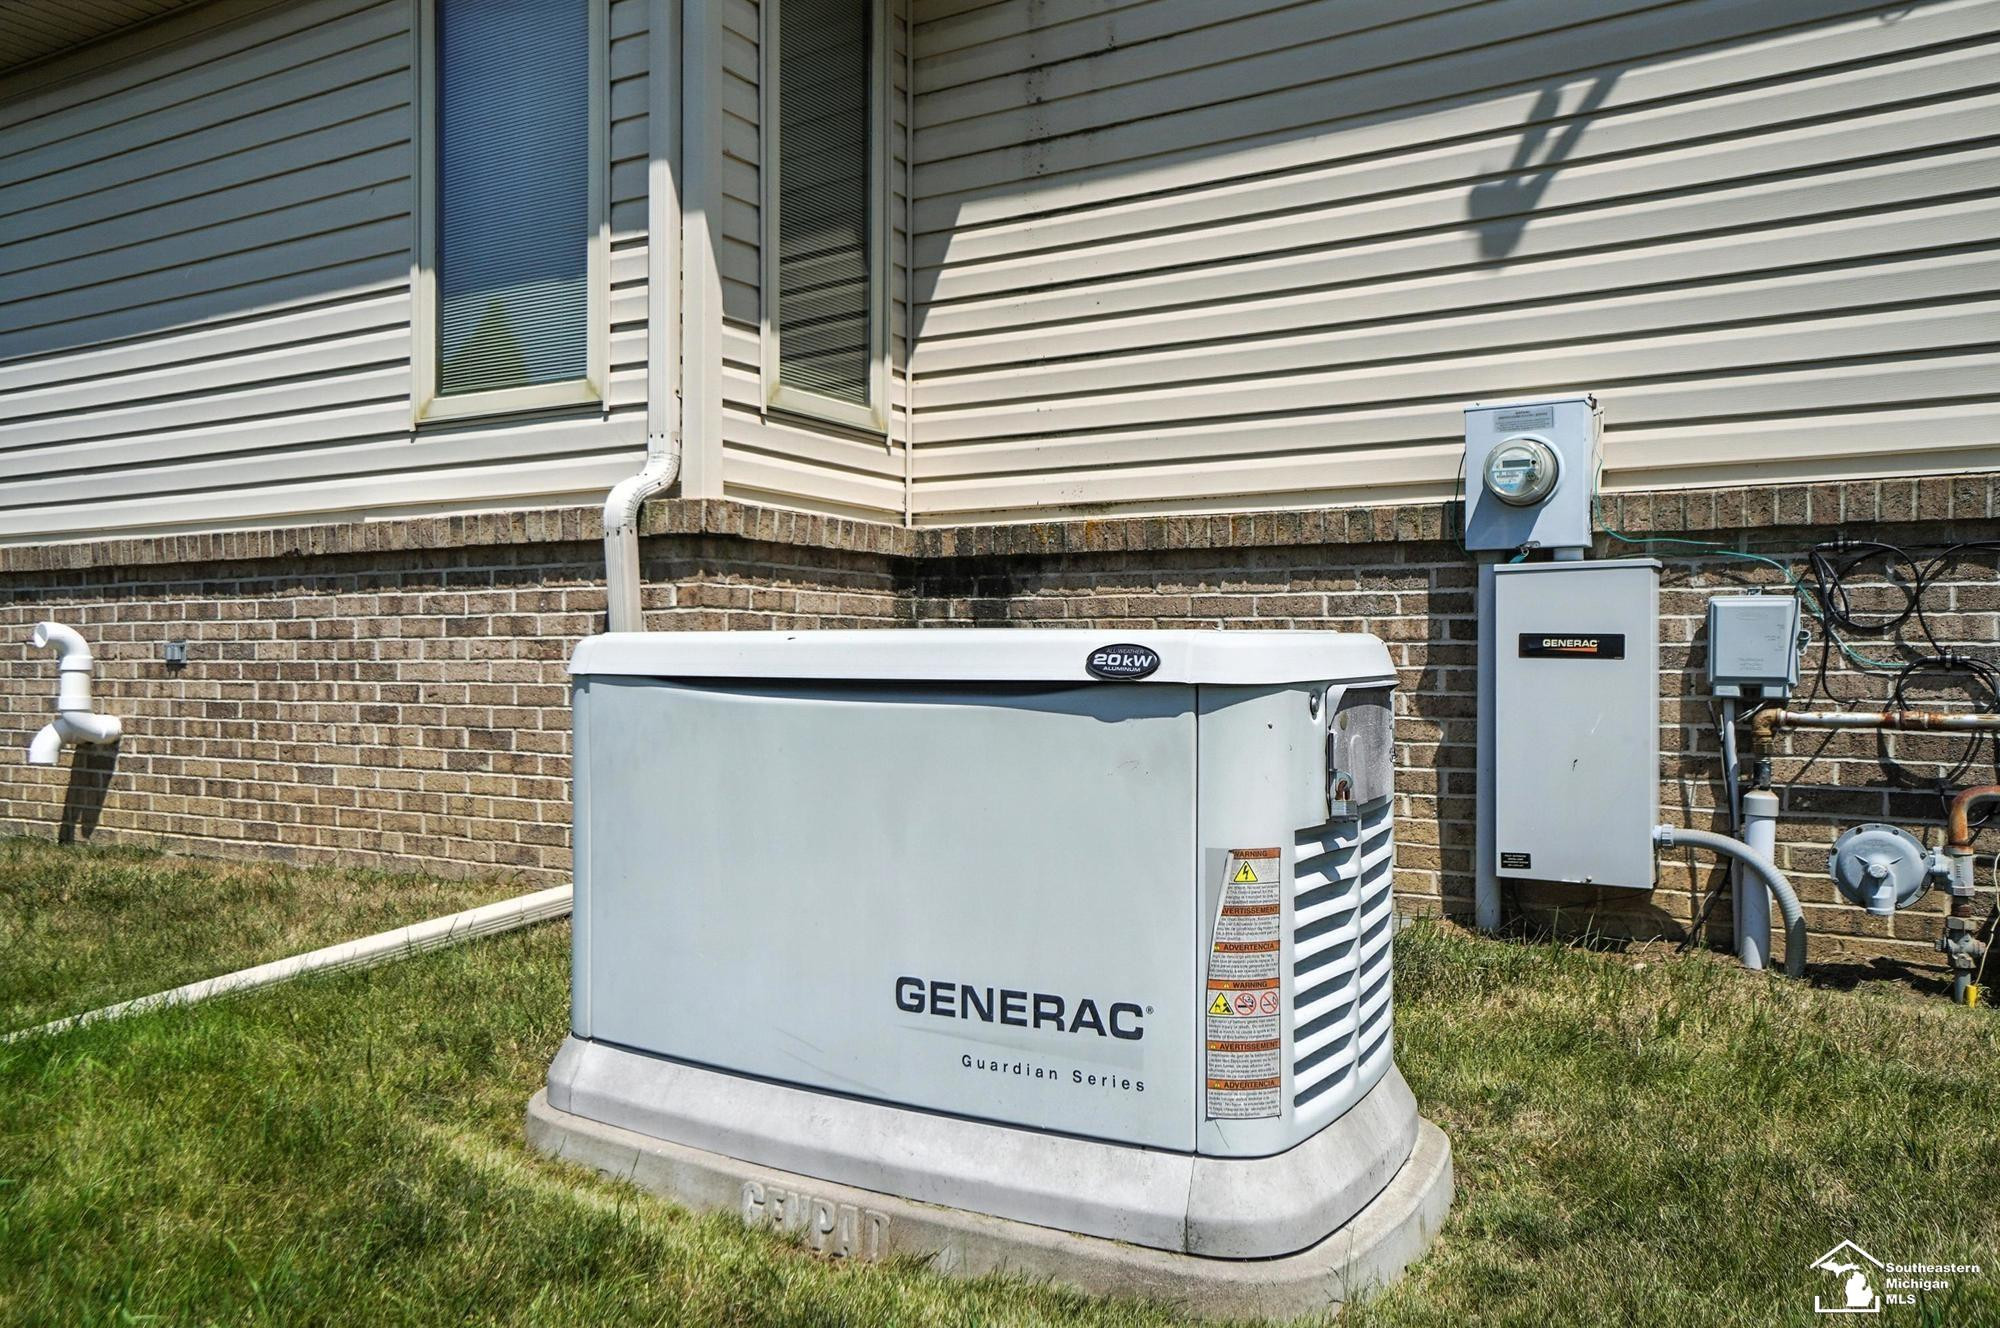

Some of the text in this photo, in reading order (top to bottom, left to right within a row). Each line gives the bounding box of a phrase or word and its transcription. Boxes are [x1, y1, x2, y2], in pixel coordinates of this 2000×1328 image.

[1542, 639, 1598, 648] GENERAC
[1223, 943, 1275, 951] ADVERTENCIA
[1220, 1041, 1278, 1050] AVERTISSEMENT
[961, 1054, 1145, 1092] Guardian Series
[1223, 1080, 1275, 1089] ADVERTENCIA
